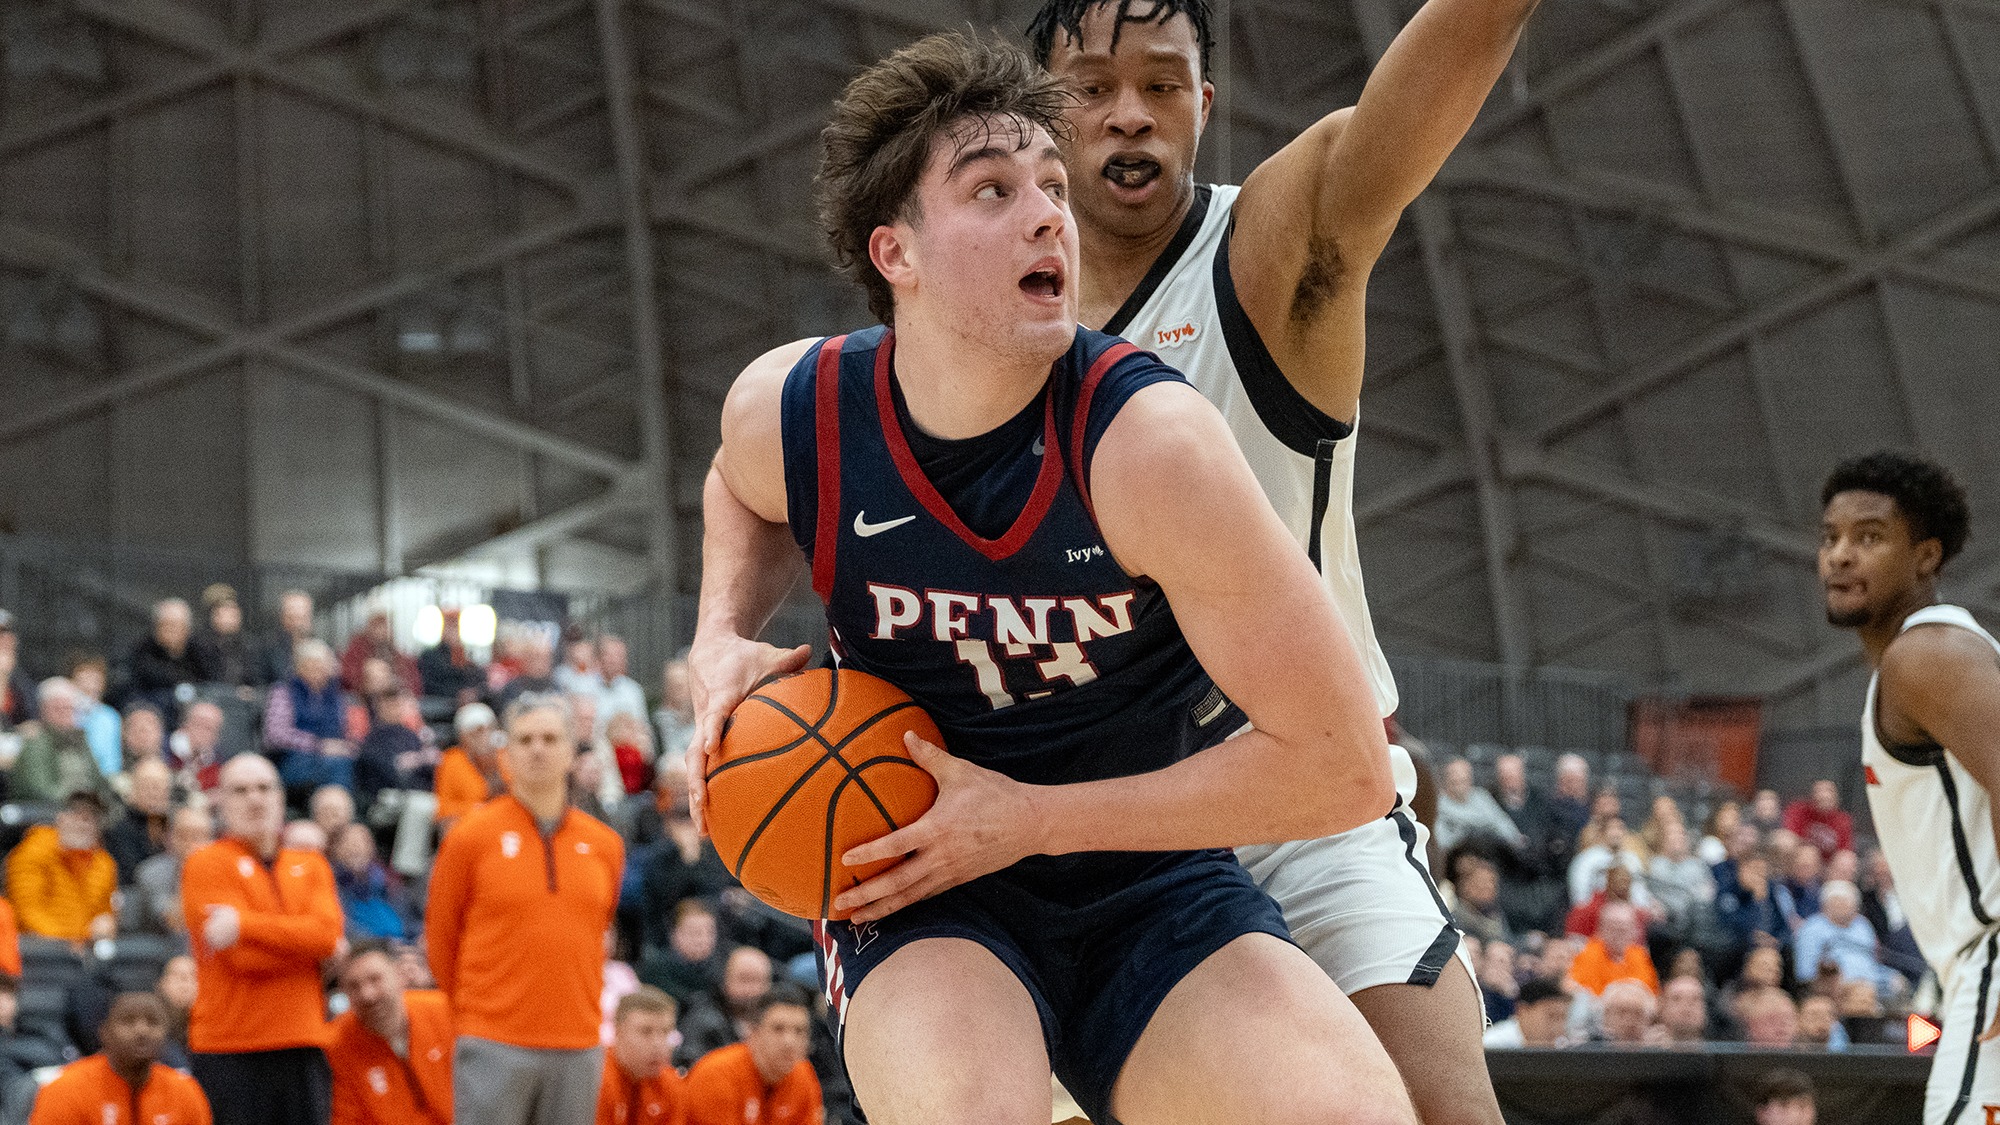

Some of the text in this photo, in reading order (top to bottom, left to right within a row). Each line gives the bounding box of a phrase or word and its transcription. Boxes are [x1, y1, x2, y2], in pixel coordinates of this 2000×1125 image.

[1157, 327, 1181, 344] Ivy
[1065, 547, 1091, 563] Ivy
[867, 580, 1135, 645] PENN
[954, 638, 1099, 710] 13
